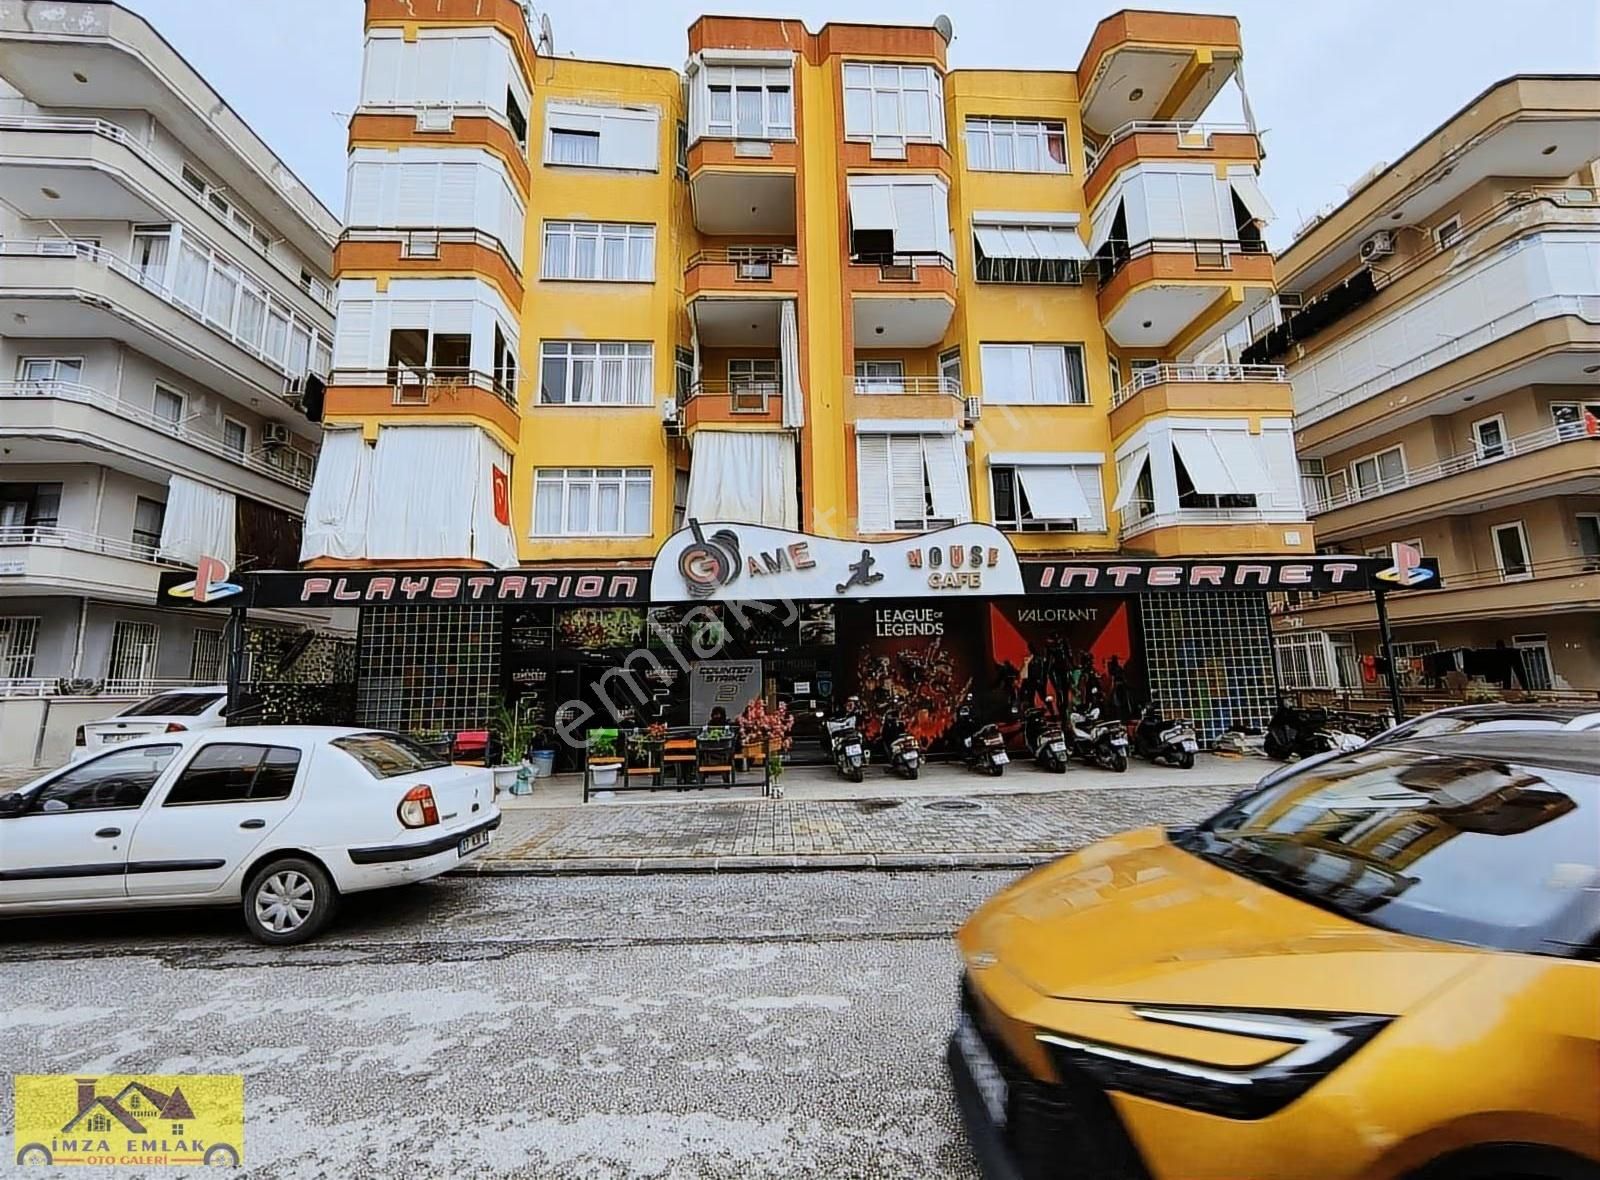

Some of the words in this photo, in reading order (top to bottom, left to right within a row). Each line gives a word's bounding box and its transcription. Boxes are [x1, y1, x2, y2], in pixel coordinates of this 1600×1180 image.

[927, 571, 982, 589] CAFE
[1041, 564, 1357, 588] INTERNET
[301, 576, 637, 600] PLAYSTATION
[875, 608, 934, 623] LEAGUE
[1017, 608, 1098, 621] VALORANT
[876, 622, 944, 636] LEGENDS
[699, 666, 753, 674] COUNTER
[704, 674, 747, 682] STRIKE
[715, 684, 738, 702] 2
